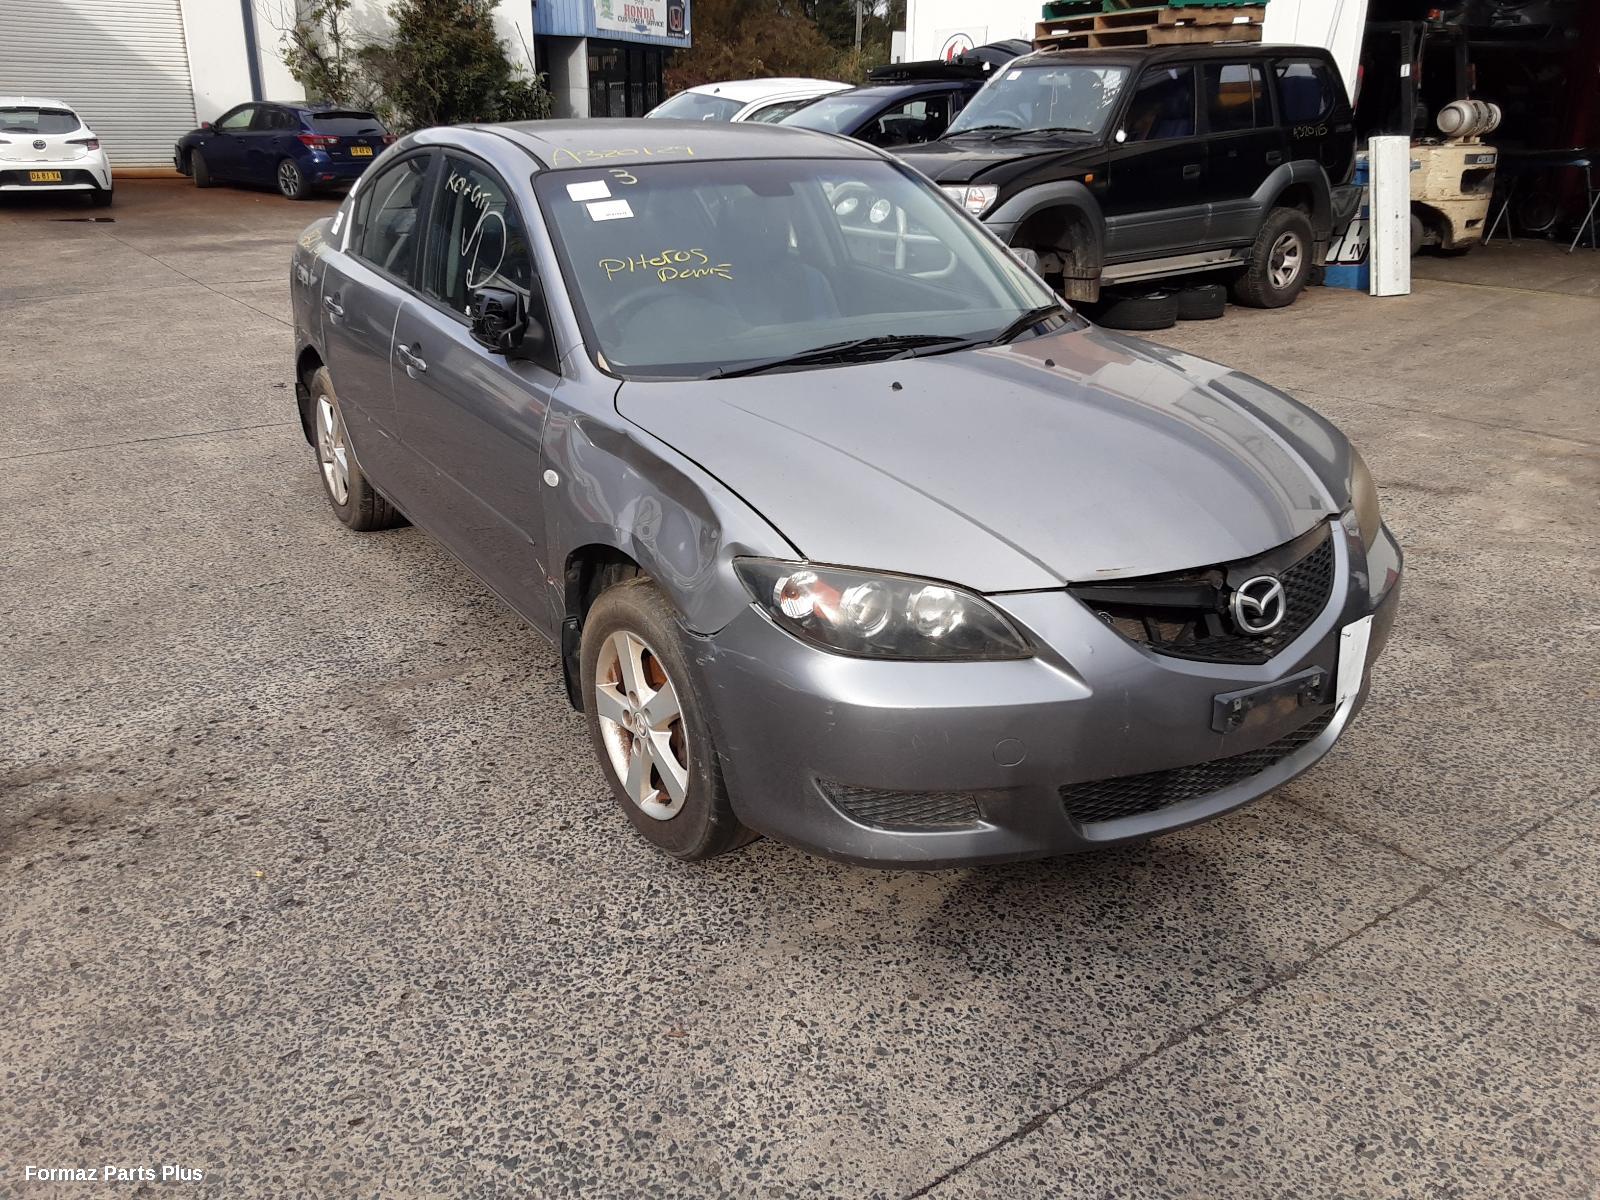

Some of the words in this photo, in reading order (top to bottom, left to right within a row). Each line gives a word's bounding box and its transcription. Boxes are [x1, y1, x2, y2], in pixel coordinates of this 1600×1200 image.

[618, 15, 645, 25] CUSTOMER
[624, 4, 656, 20] HONDA
[609, 168, 638, 185] 3
